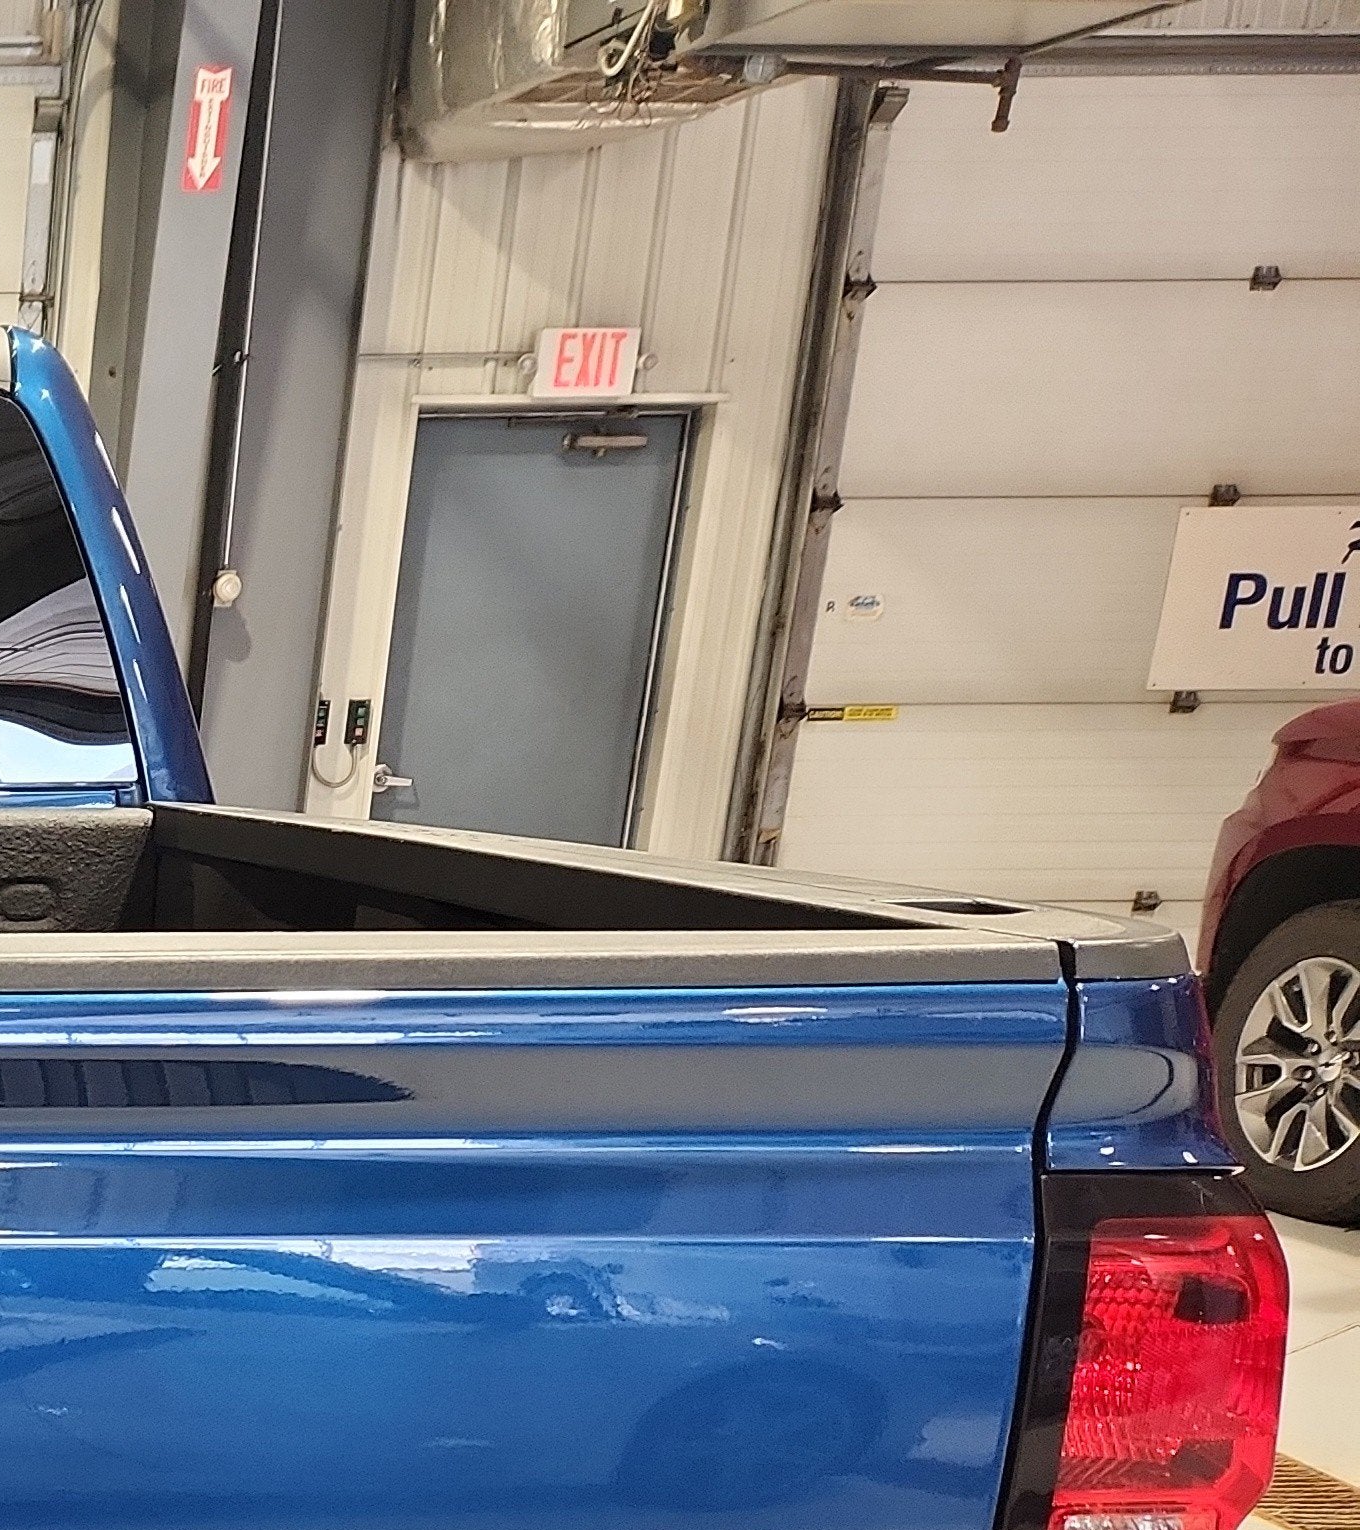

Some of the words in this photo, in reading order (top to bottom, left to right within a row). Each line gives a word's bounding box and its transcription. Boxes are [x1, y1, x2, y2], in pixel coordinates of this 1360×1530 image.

[200, 79, 226, 94] FIRE
[553, 331, 628, 387] EXIT
[1218, 571, 1347, 630] Pull
[1314, 636, 1355, 675] to
